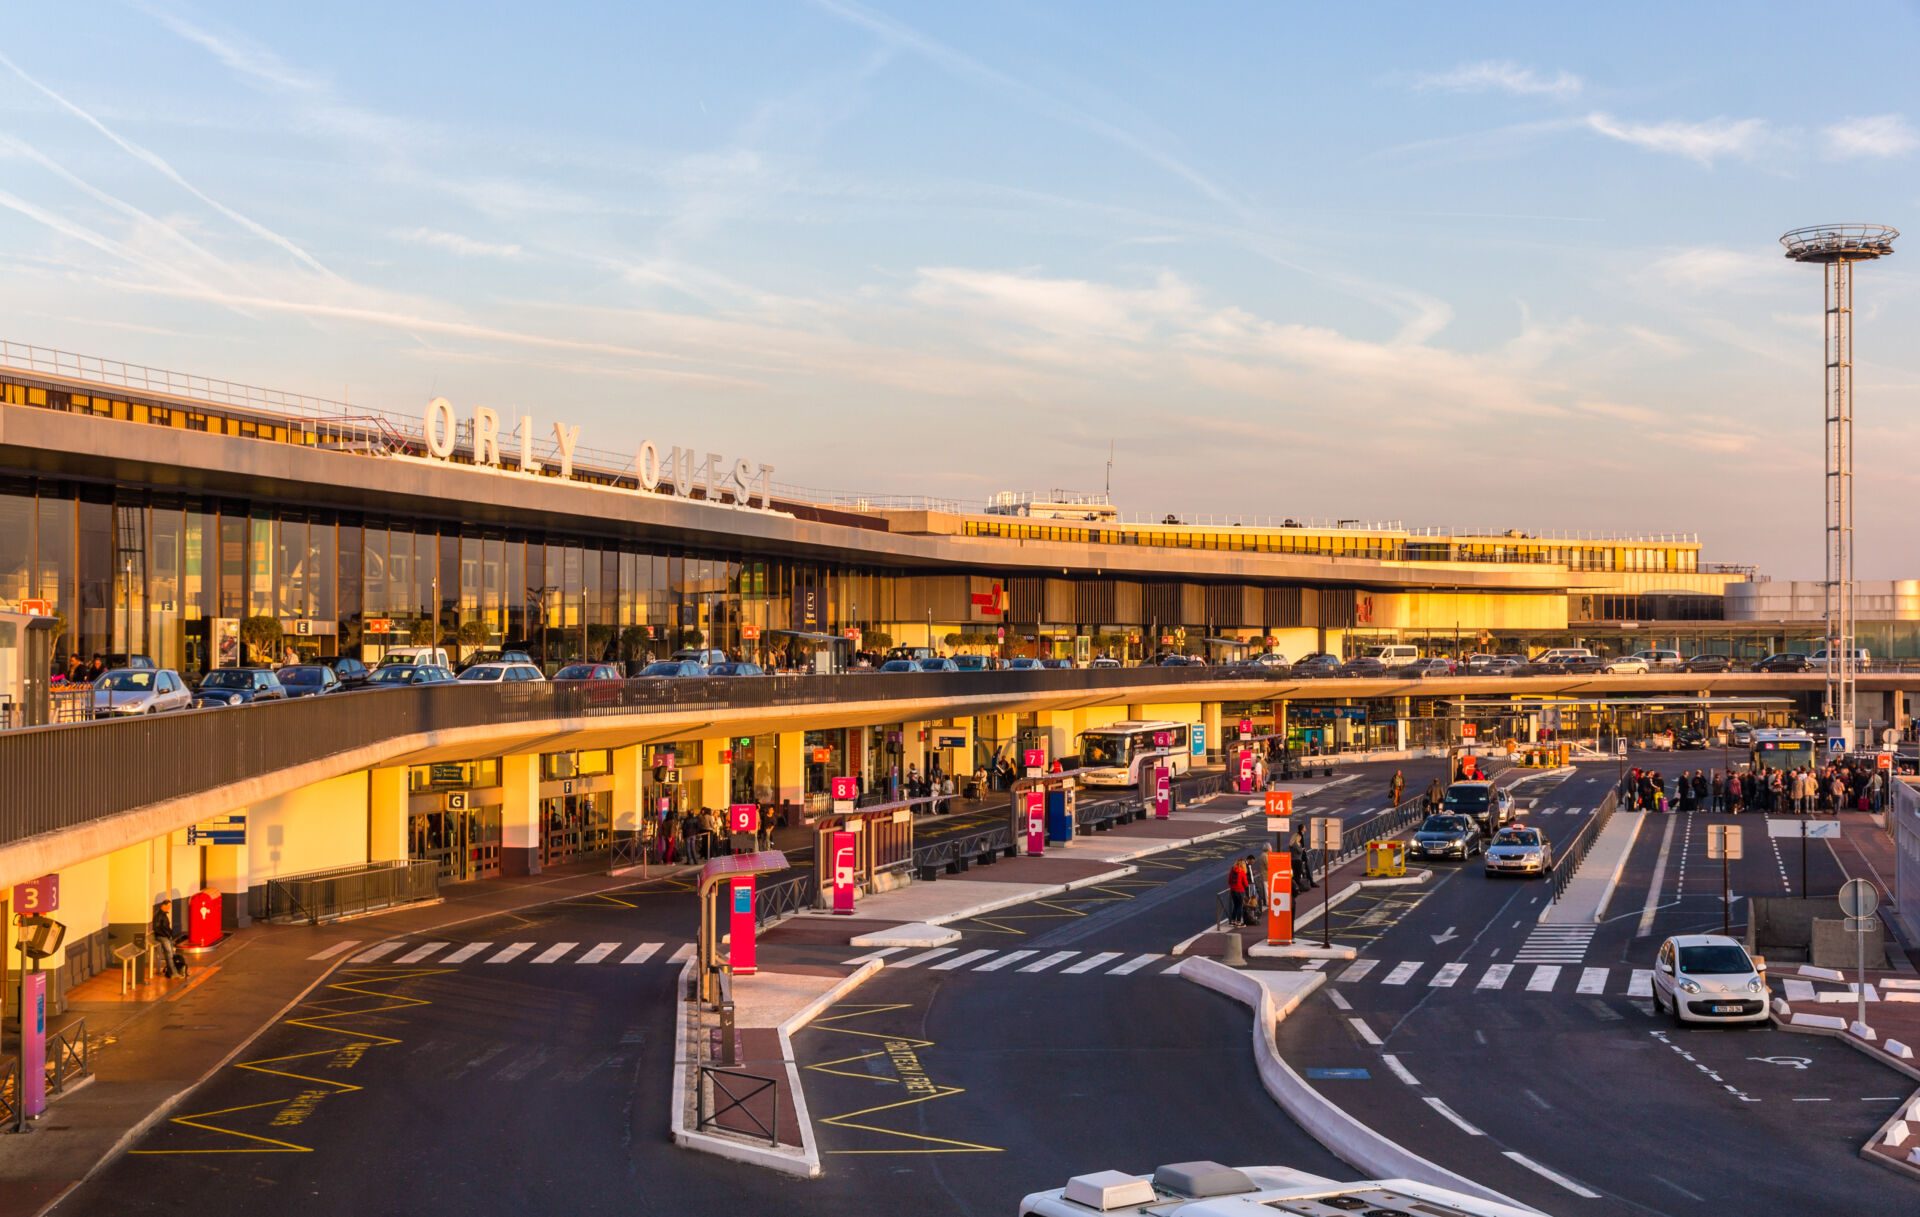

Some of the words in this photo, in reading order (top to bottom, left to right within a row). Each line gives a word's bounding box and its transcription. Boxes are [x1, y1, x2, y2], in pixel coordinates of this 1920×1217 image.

[424, 396, 580, 476] ORLY
[639, 439, 775, 507] OUEST
[299, 623, 306, 633] E
[1029, 755, 1036, 765] 7
[838, 784, 846, 796] 8
[452, 796, 462, 808] G
[1268, 800, 1285, 813] 14
[739, 813, 749, 828] 9
[24, 888, 39, 908] 3
